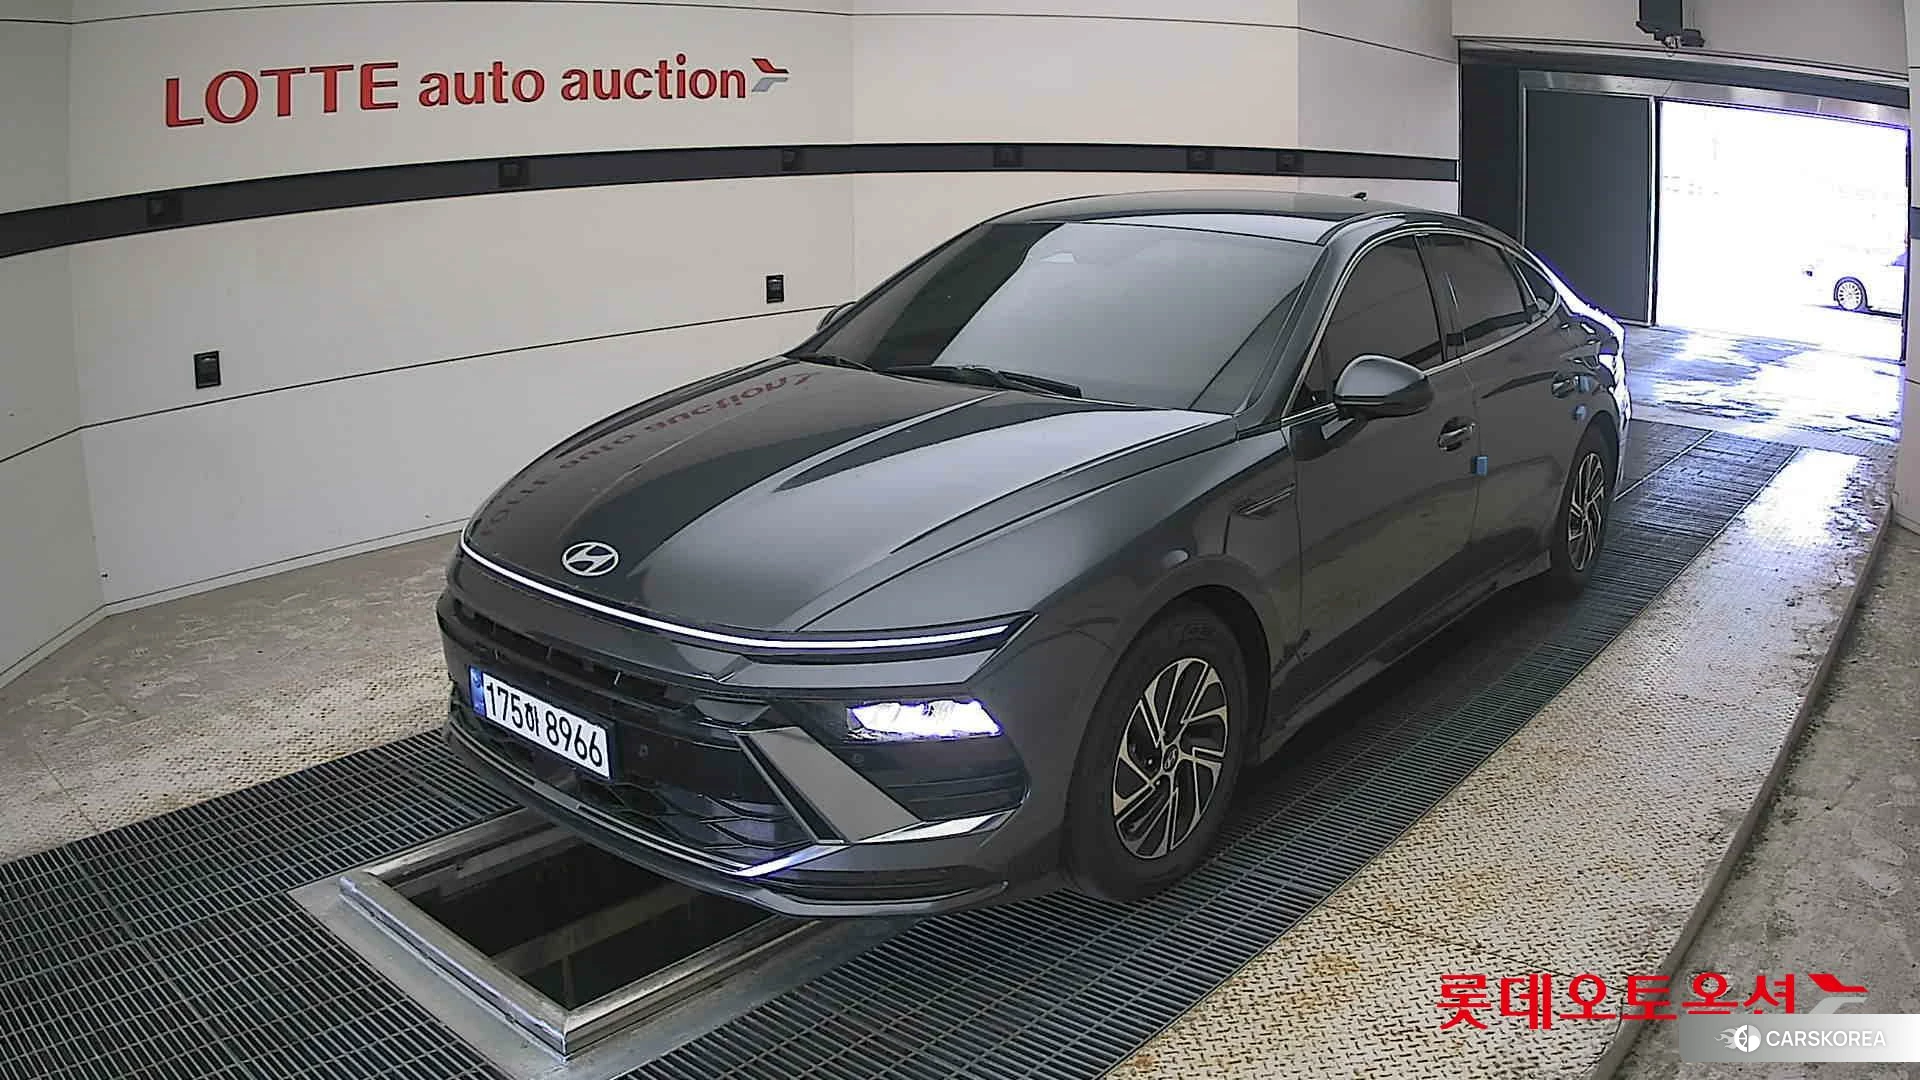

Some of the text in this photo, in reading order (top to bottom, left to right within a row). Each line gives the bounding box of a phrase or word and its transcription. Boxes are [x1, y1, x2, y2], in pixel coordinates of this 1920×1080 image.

[165, 53, 746, 127] LOTTE auto auction
[486, 681, 603, 768] 175하 8966
